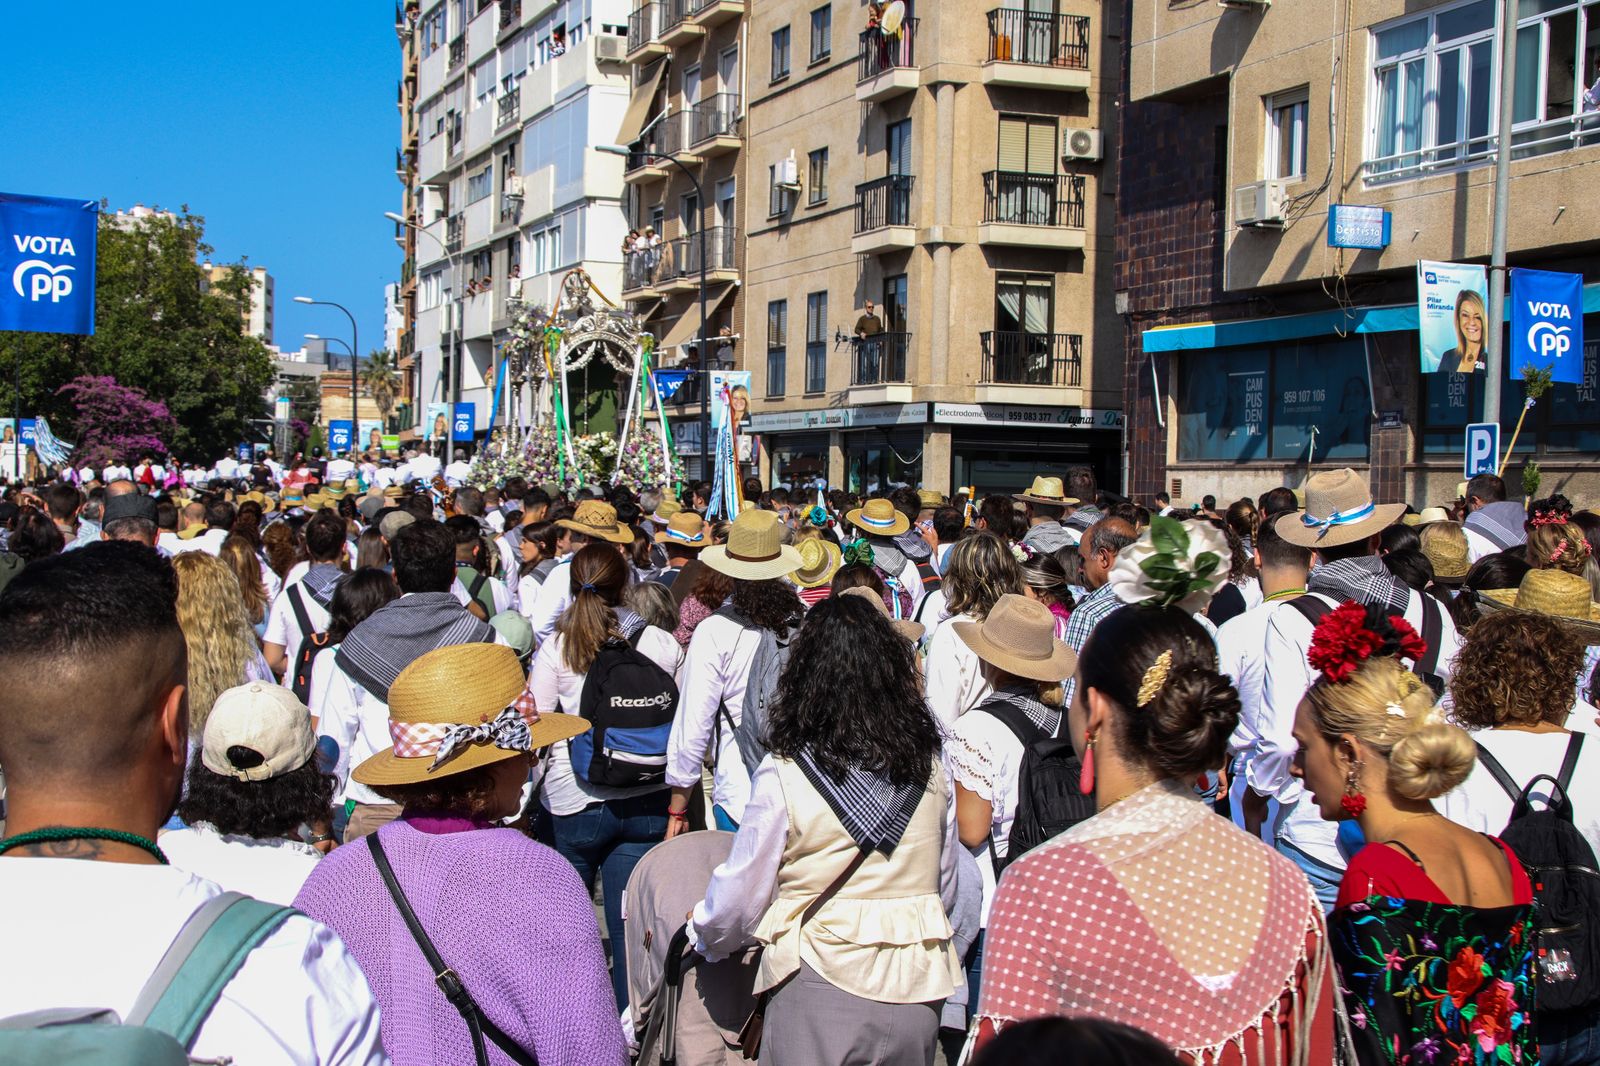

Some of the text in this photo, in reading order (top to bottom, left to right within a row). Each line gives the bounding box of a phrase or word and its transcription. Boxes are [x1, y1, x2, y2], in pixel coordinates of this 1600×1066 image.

[1336, 224, 1380, 237] Dentista
[13, 234, 76, 257] VOTA
[1527, 301, 1571, 319] VOTA
[1245, 378, 1263, 392] CAM
[1447, 383, 1466, 396] DEN
[1245, 392, 1262, 408] PUS
[1283, 389, 1326, 404] 959 107 106
[1448, 396, 1465, 408] TAL
[1576, 388, 1597, 403] TAL
[1008, 411, 1022, 421] 959
[1023, 411, 1037, 422] 083
[1038, 412, 1052, 422] 377
[1244, 408, 1262, 422] DEN
[1245, 422, 1262, 436] TAL
[1470, 429, 1492, 475] P
[610, 691, 672, 708] Reebok
